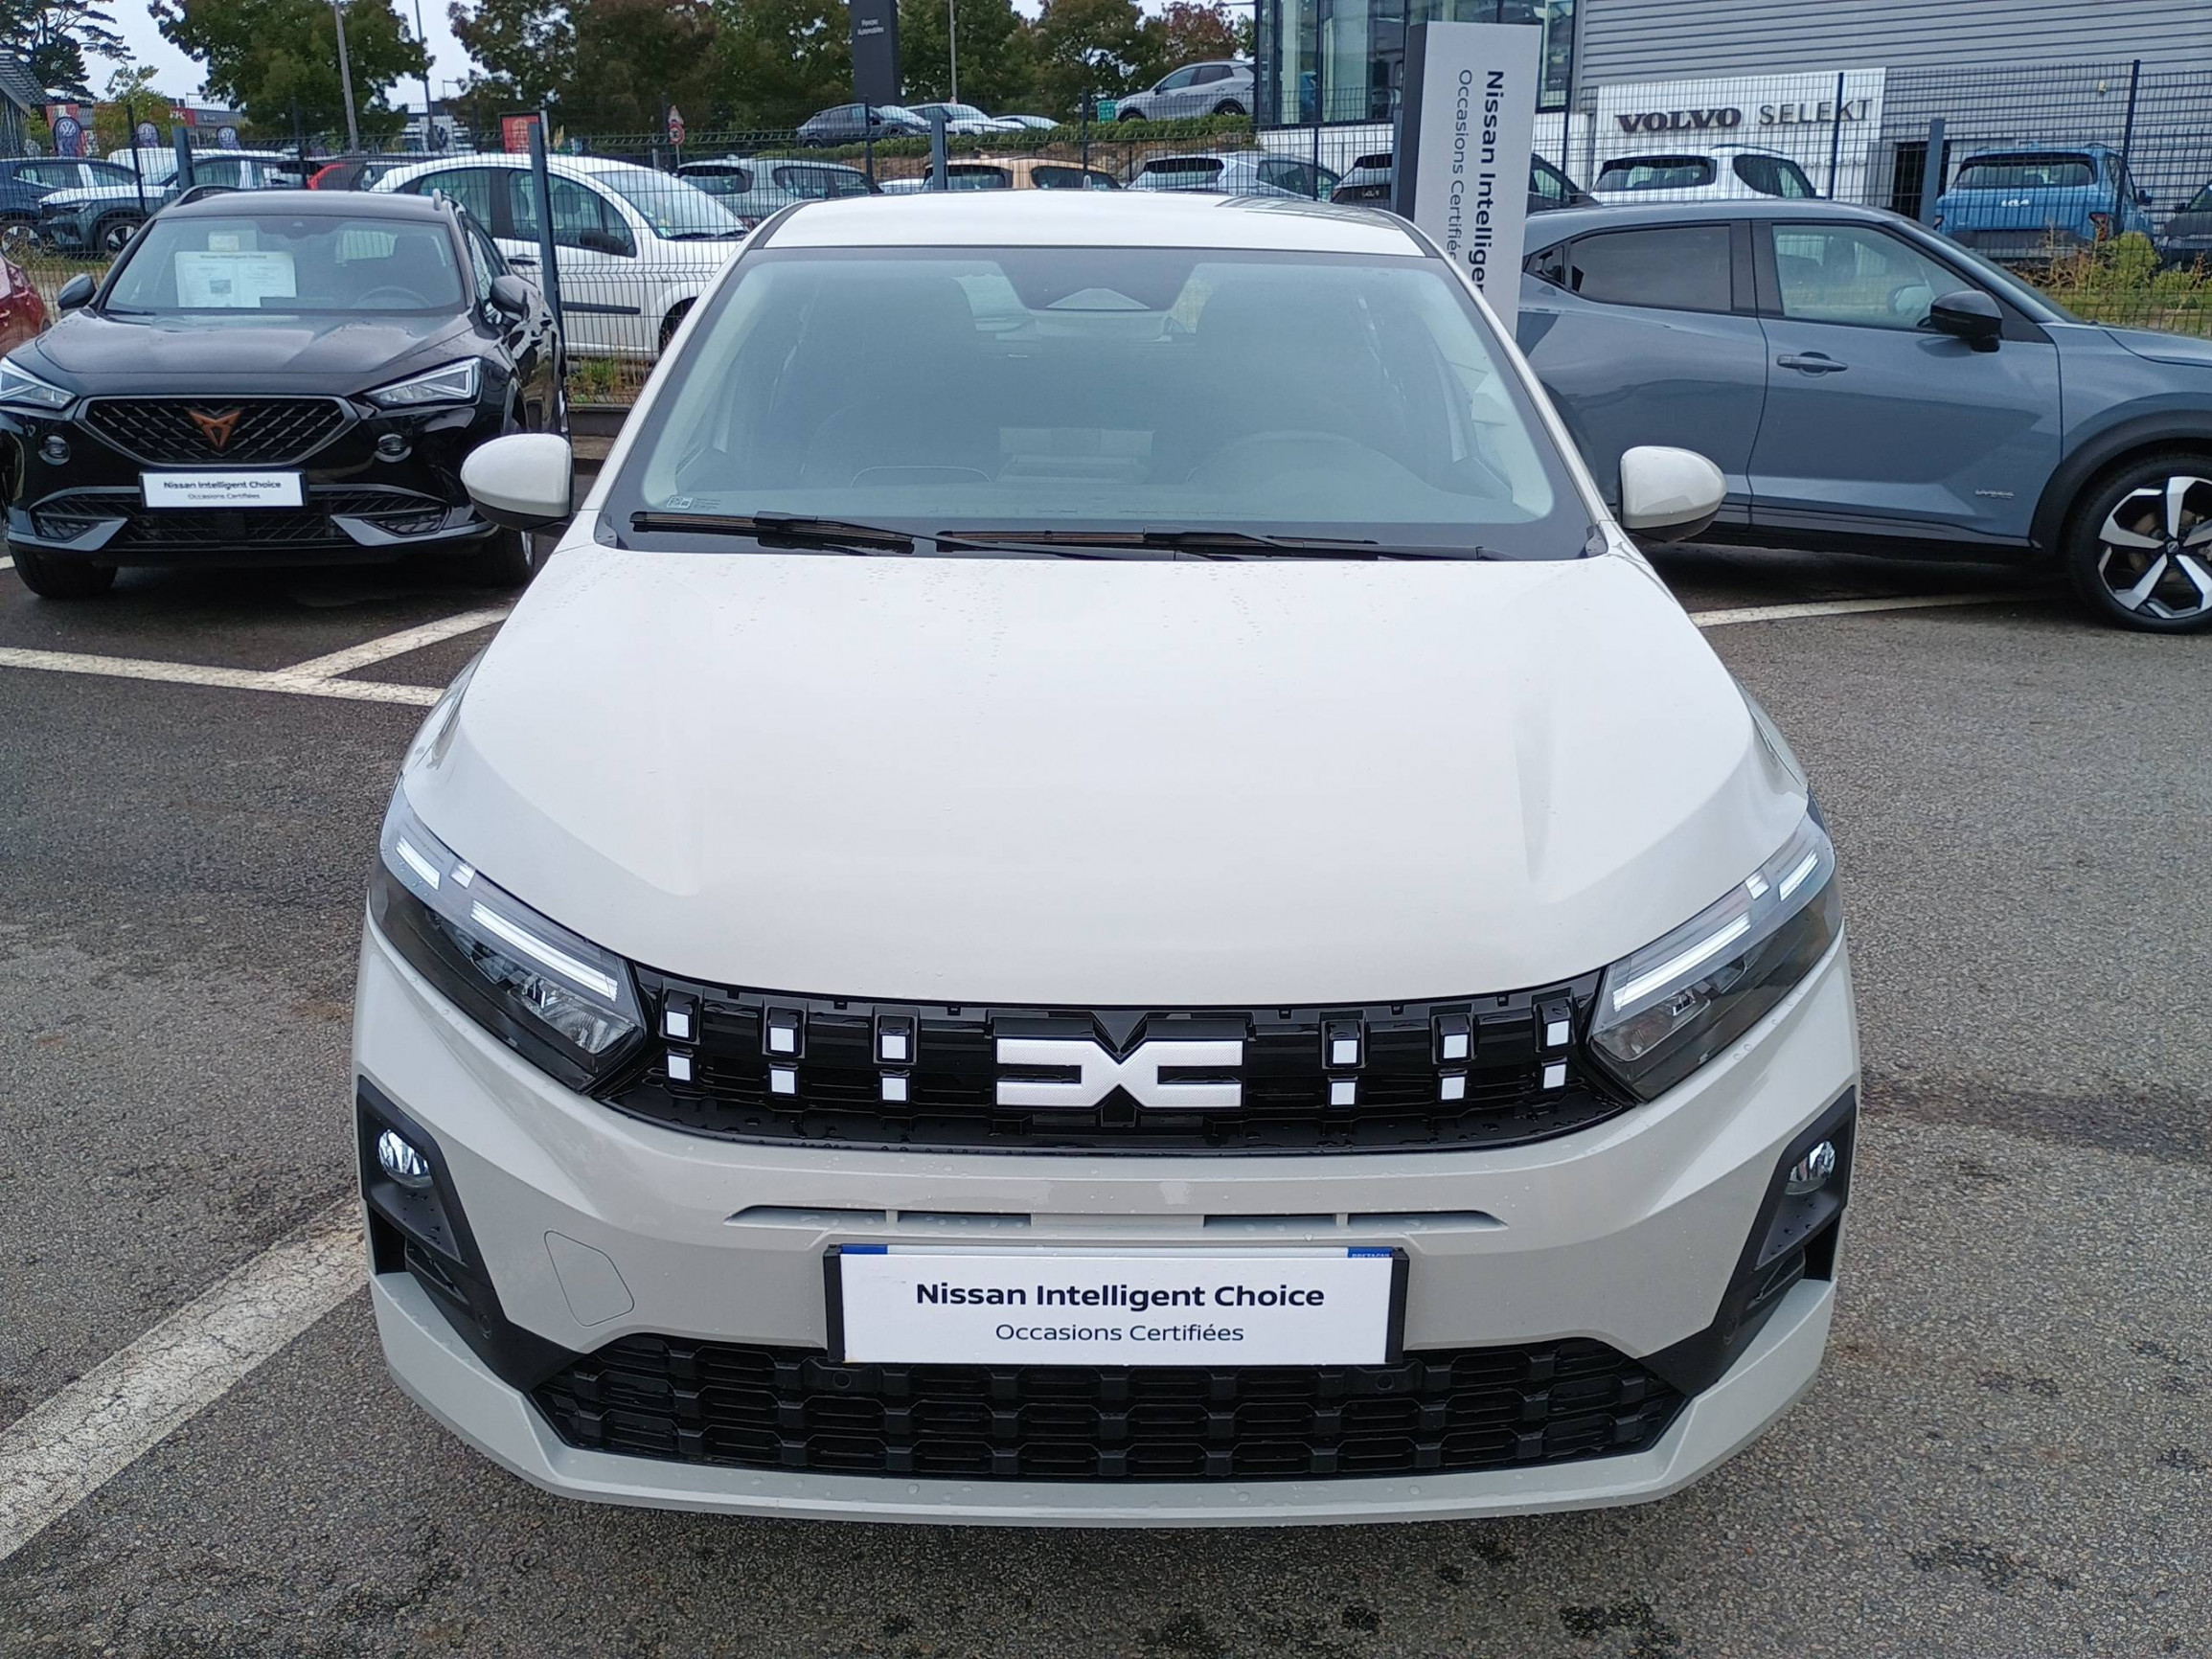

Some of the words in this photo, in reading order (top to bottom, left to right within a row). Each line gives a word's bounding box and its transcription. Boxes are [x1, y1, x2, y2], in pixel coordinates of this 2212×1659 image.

[1452, 69, 1472, 174] Occasions
[1480, 71, 1504, 164] Nissan
[1615, 107, 1742, 133] VOLVO
[1759, 99, 1873, 125] SELEKT
[164, 481, 196, 489] Nissan
[198, 481, 247, 490] Intelligent
[249, 480, 282, 489] Choice
[916, 1282, 1027, 1306] Nissan
[1037, 1284, 1206, 1313] Intelligent
[1214, 1284, 1326, 1307] Choice
[995, 1324, 1123, 1341] Occasions
[1129, 1323, 1245, 1341] Certifiées
